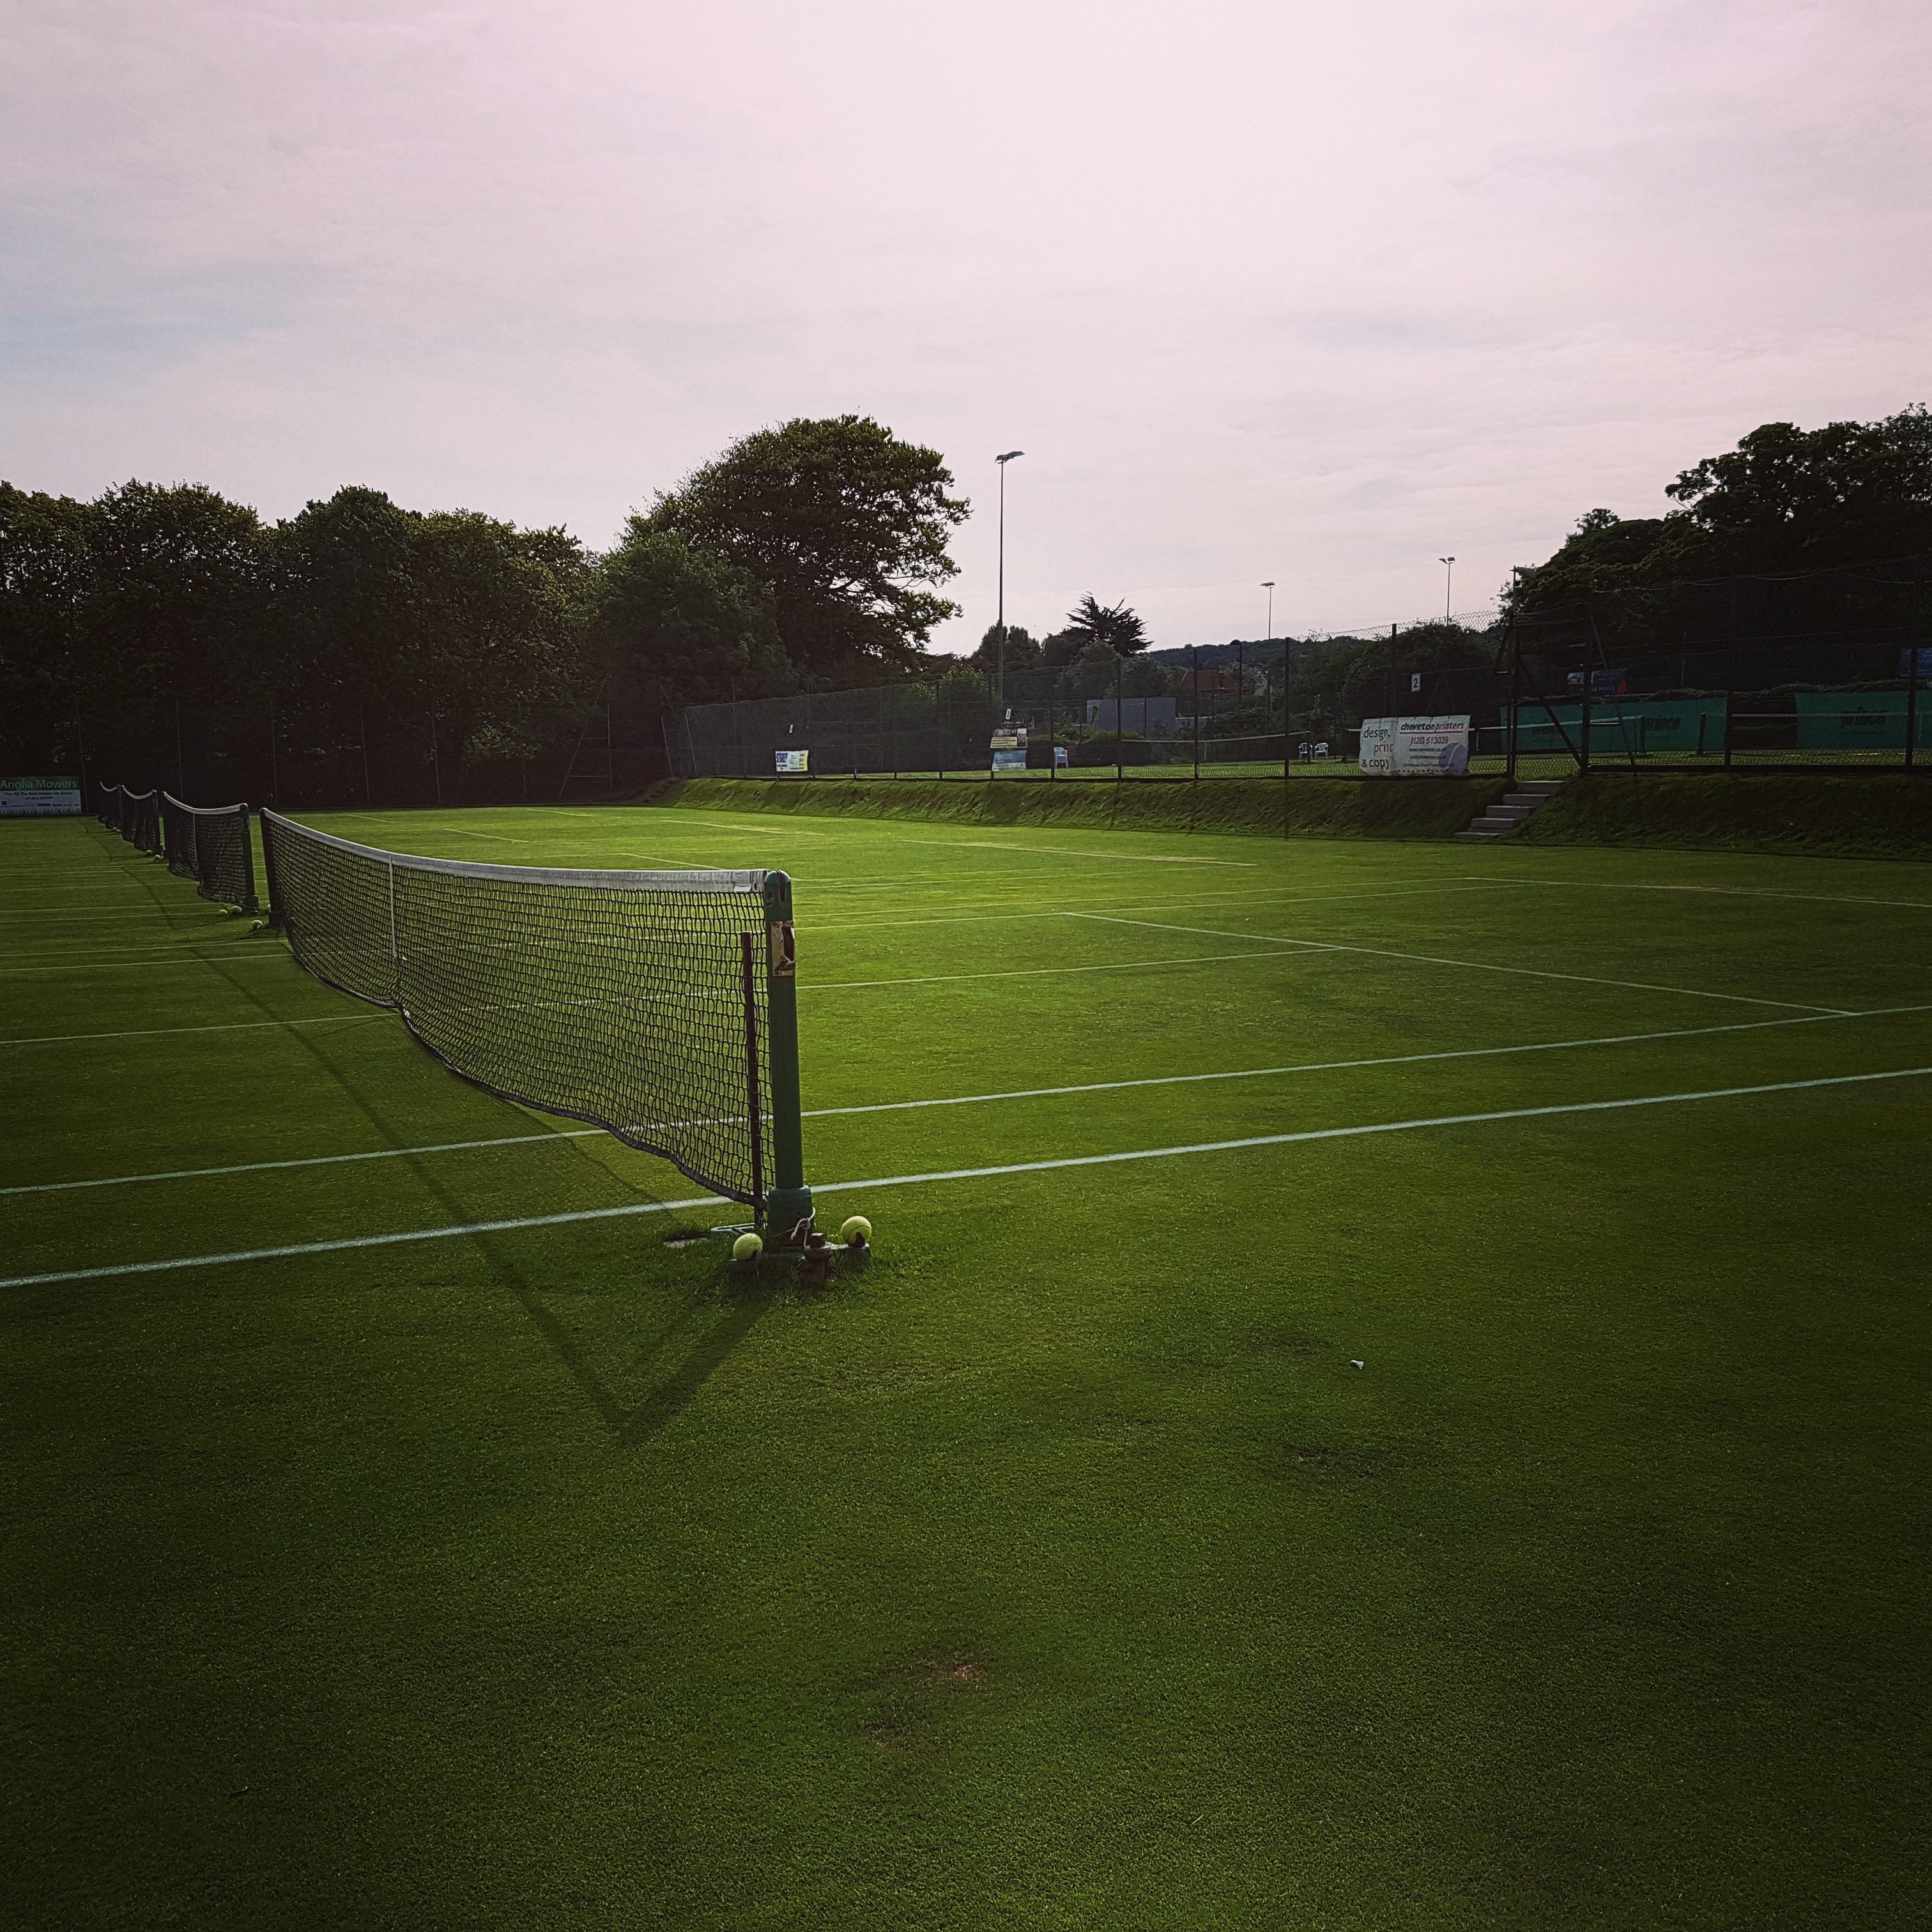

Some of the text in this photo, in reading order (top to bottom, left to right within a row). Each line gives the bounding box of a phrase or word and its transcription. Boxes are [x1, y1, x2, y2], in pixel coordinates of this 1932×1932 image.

[1413, 678, 1418, 688] 2
[1363, 726, 1391, 740] design,
[1361, 759, 1367, 767] &
[0, 779, 77, 790] Anglia Mowers
